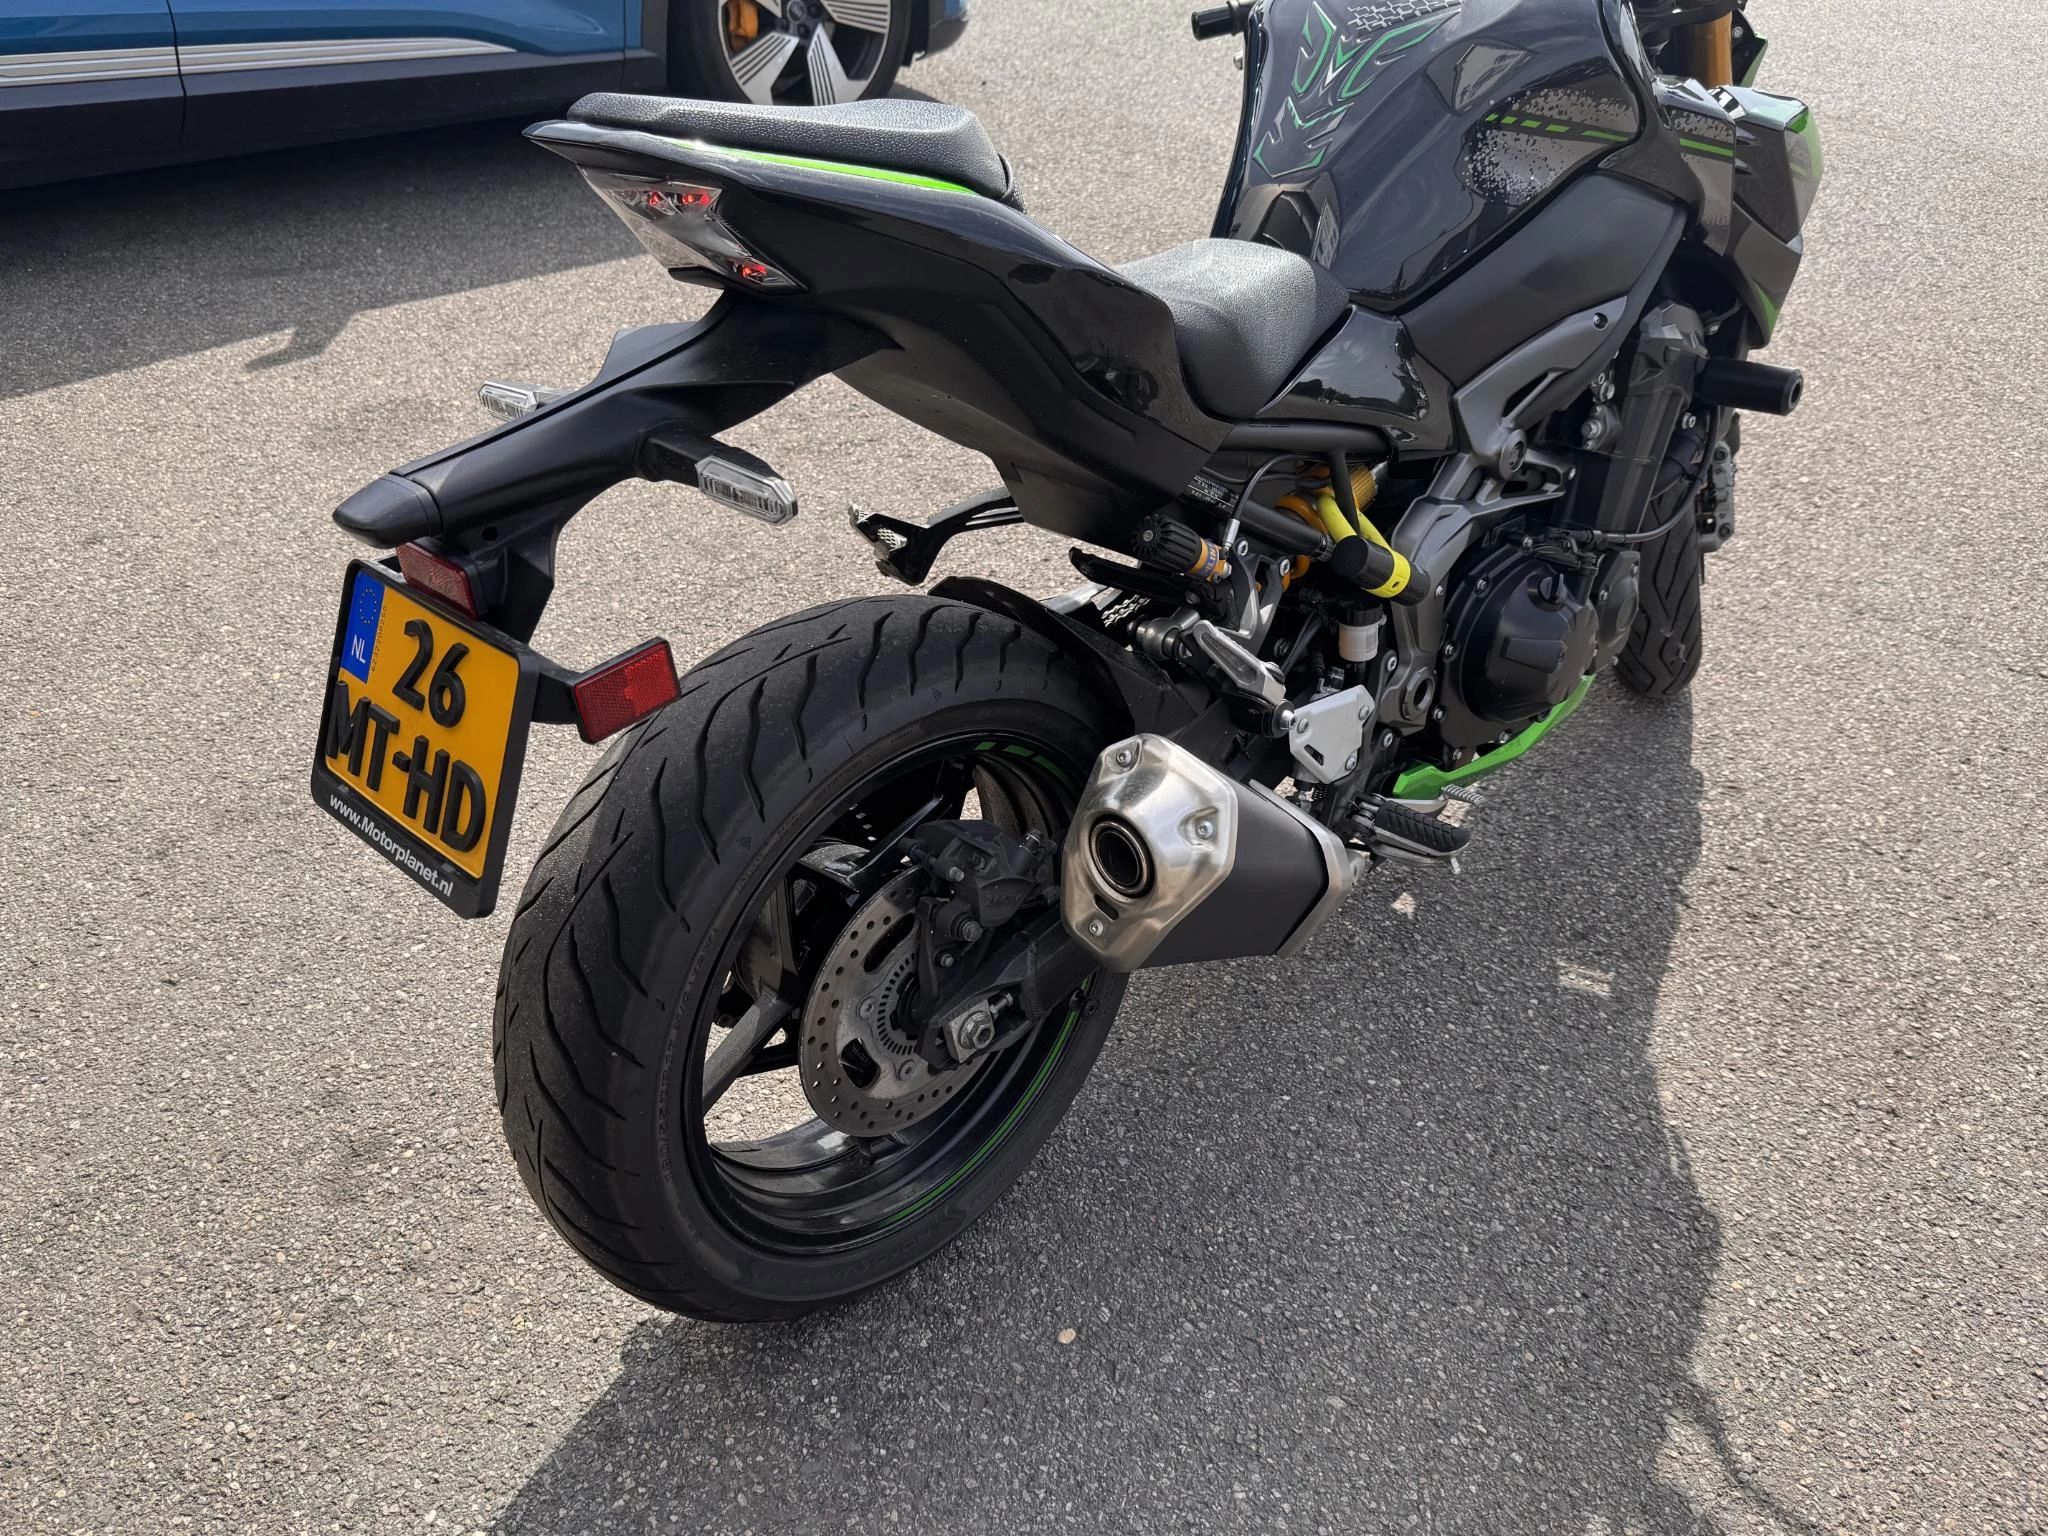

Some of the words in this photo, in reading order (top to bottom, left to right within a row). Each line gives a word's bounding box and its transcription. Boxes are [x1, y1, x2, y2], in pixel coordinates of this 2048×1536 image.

[351, 635, 366, 664] NL
[392, 618, 468, 728] 26
[325, 680, 487, 853] MT-HD
[330, 793, 455, 898] www.Motorplanet.nl
